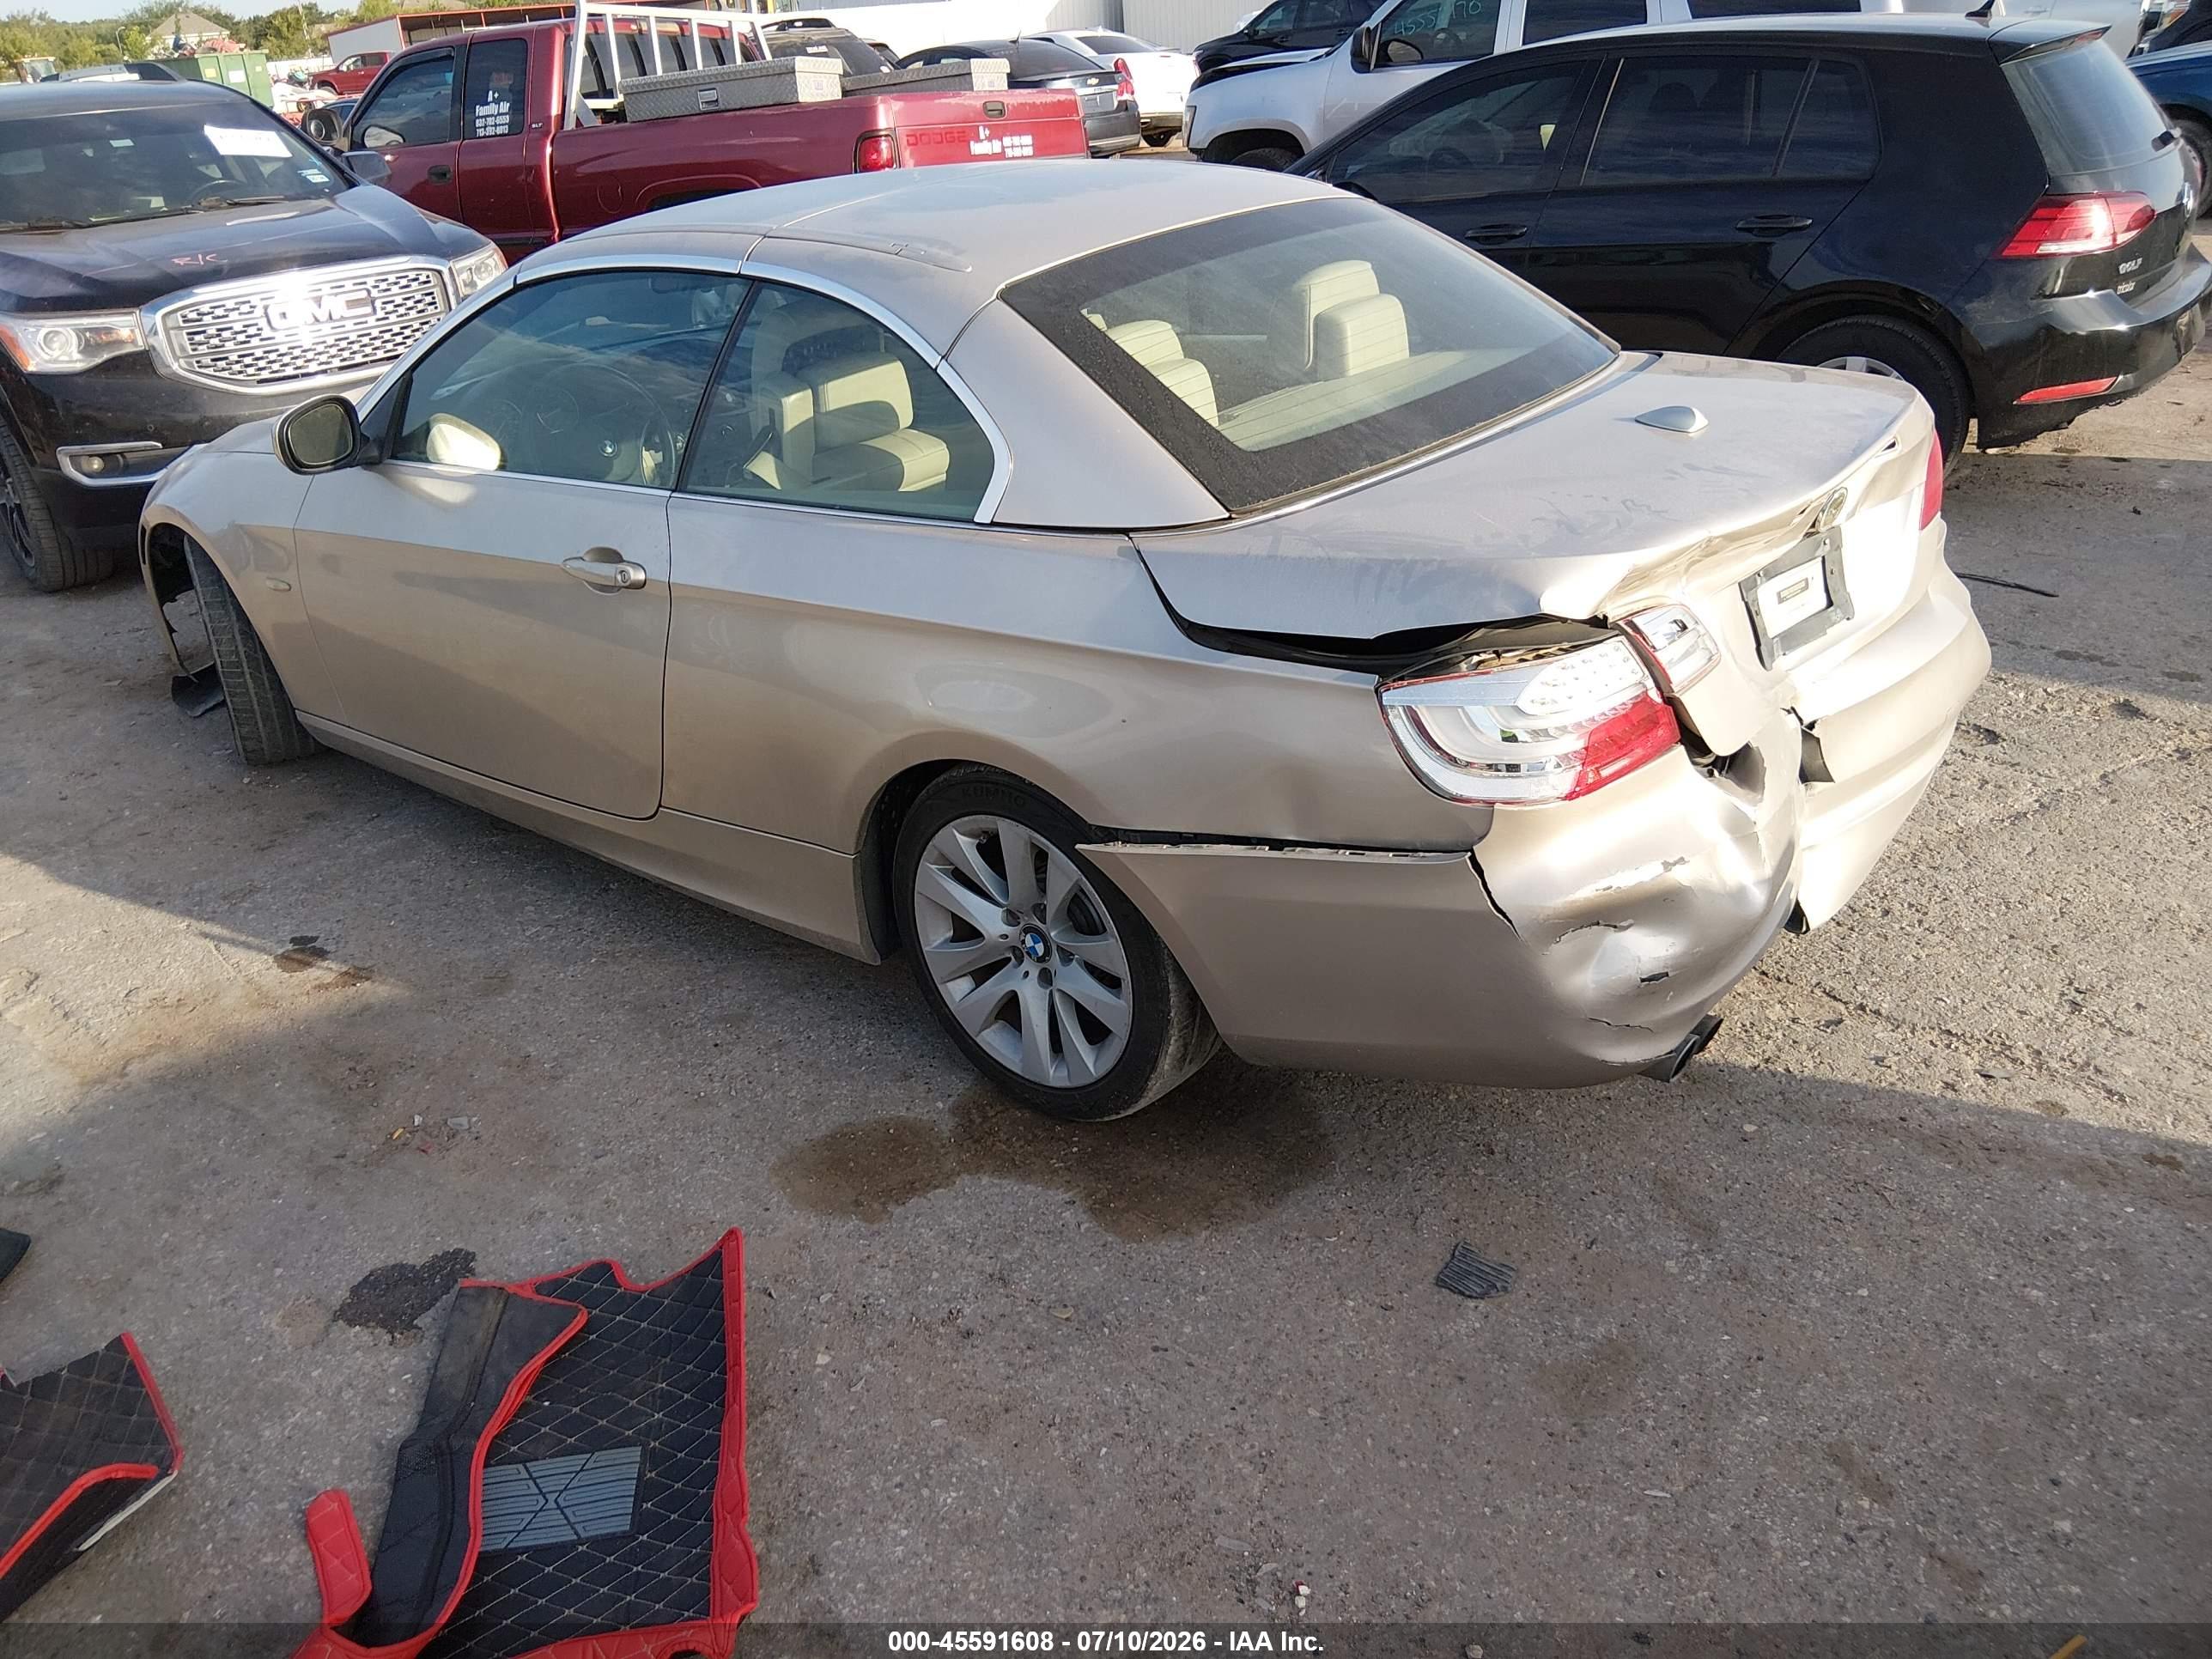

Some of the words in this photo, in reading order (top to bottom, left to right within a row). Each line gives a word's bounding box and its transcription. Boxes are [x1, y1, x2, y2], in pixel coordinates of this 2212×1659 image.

[476, 103, 498, 117] Family
[499, 101, 510, 113] Air
[906, 131, 967, 146] DODGE
[2118, 258, 2142, 274] GOLF
[263, 287, 375, 331] GMC
